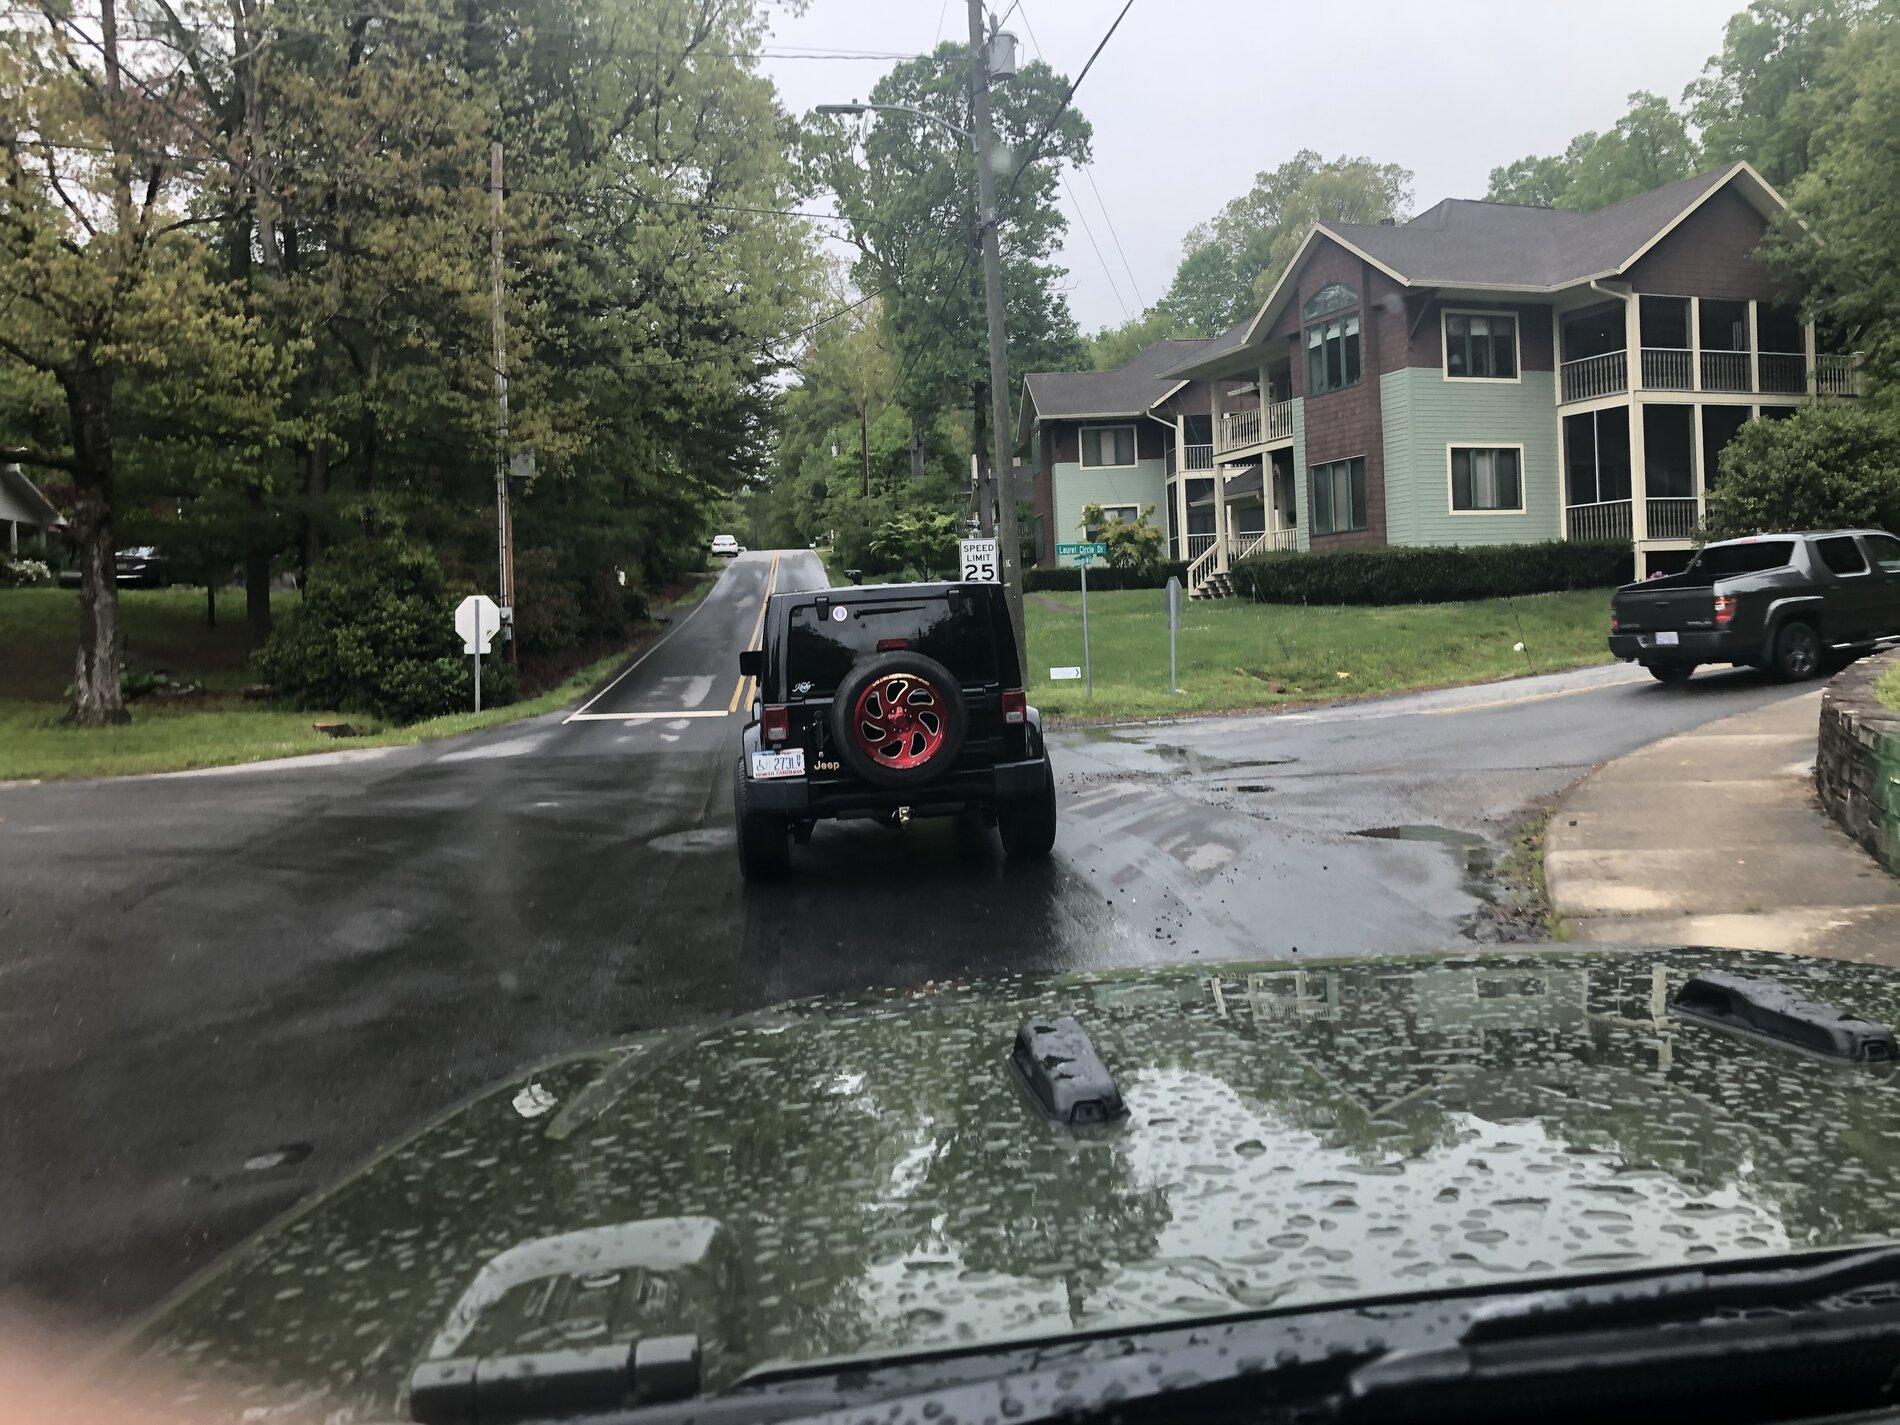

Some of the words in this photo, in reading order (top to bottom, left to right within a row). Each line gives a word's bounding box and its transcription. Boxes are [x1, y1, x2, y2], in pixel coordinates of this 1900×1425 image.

[963, 544, 995, 552] SPEED
[1058, 545, 1076, 554] Laurel
[1079, 545, 1095, 554] Circle
[966, 554, 991, 562] LIMIT
[965, 564, 995, 581] 25
[814, 760, 840, 772] Jeep
